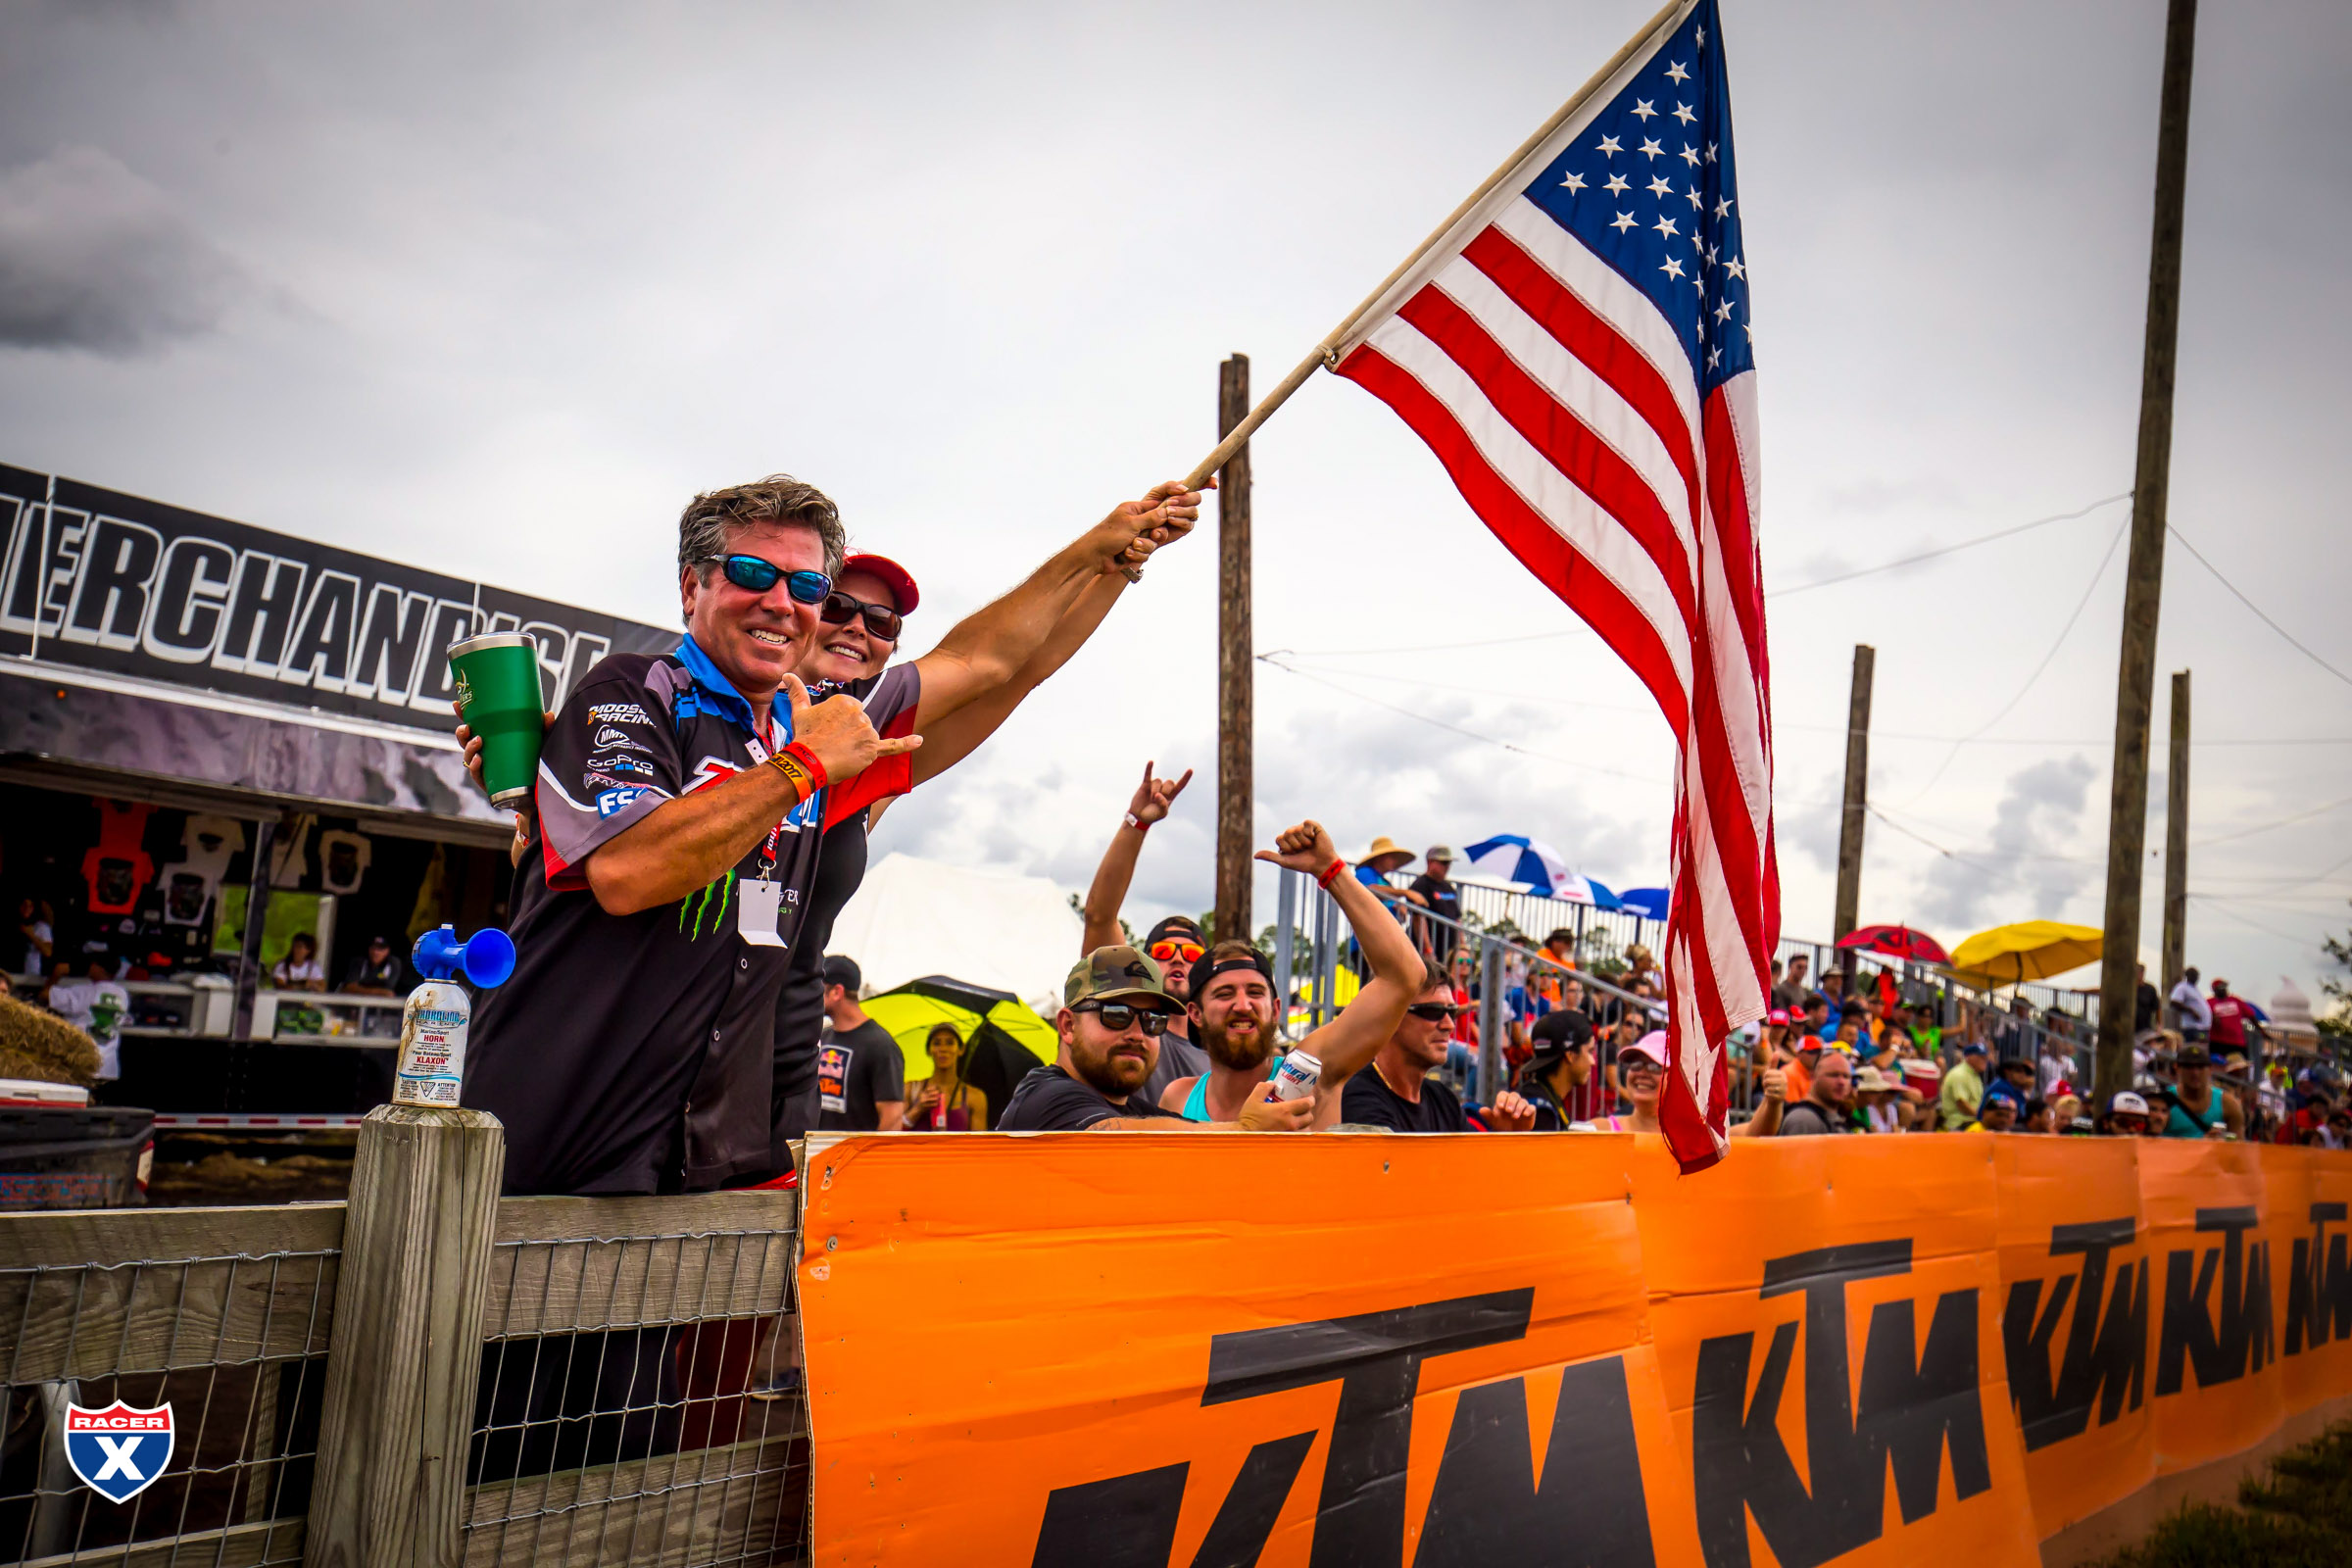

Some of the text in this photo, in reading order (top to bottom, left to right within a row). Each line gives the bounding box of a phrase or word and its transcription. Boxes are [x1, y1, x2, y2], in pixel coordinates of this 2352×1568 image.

[589, 704, 647, 715] MOOS
[595, 712, 657, 728] RACIN
[587, 754, 654, 770] GoPro
[600, 787, 645, 814] FS
[423, 1034, 445, 1043] HORN
[416, 1056, 446, 1065] KLAXON
[1281, 1060, 1311, 1082] atural
[2154, 1205, 2276, 1397] KTM
[2002, 1216, 2149, 1452] KTM
[1692, 1238, 1991, 1568] KTM
[1031, 1287, 1656, 1568] TM
